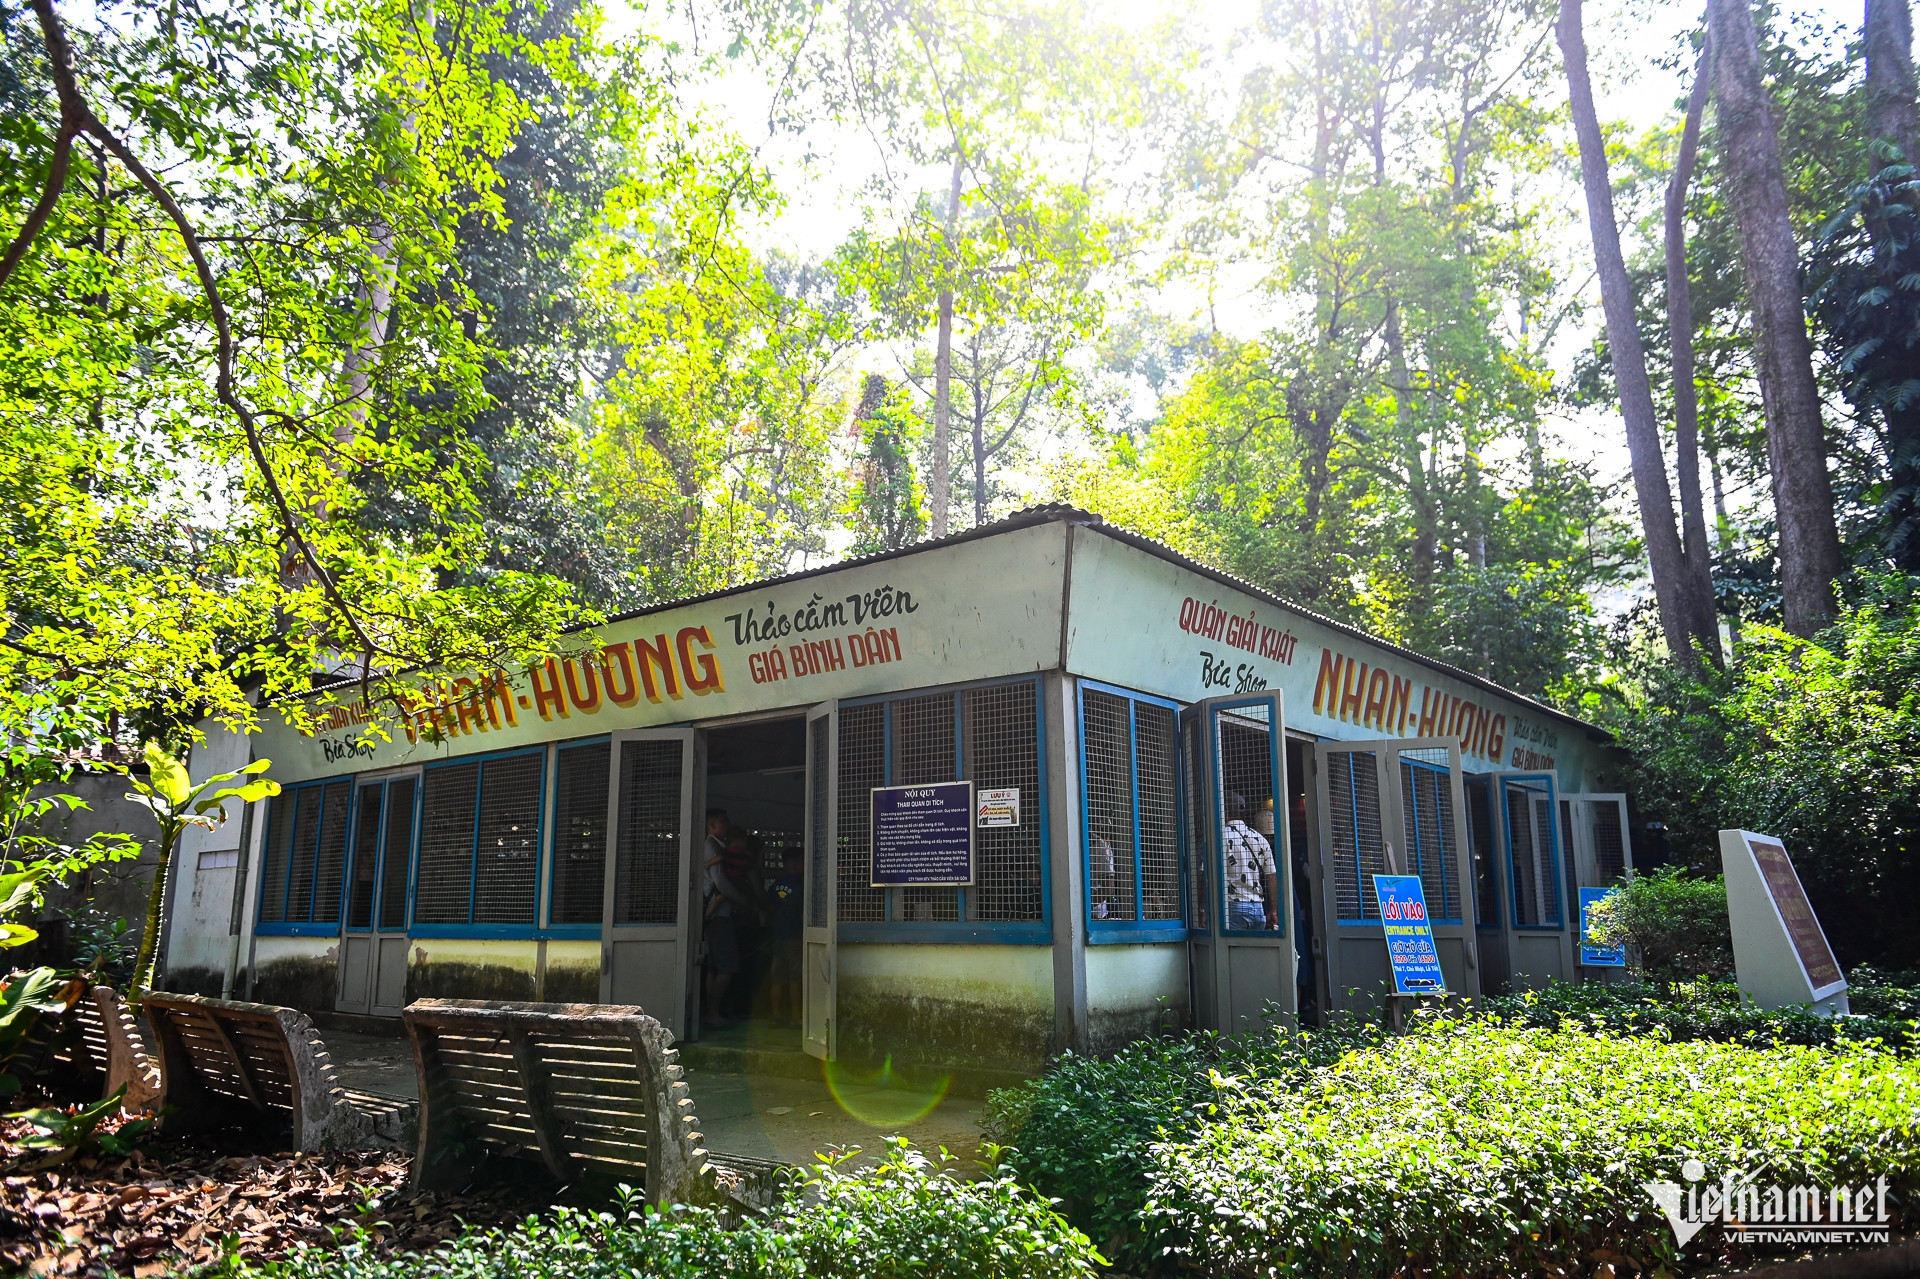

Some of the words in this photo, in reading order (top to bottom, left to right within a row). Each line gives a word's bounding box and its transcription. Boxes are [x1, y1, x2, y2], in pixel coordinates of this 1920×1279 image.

[724, 600, 792, 646] Thảo
[846, 584, 919, 625] Viên
[1179, 597, 1228, 643] QUÁN
[1225, 610, 1259, 654] GIẢI
[1258, 629, 1298, 666] KHÁT
[749, 643, 788, 684] GIÁ
[789, 638, 846, 678] BÌNH
[847, 626, 902, 669] DÂN
[1200, 650, 1231, 689] Bia
[1312, 648, 1507, 764] NHAN-HƯƠNG
[319, 739, 346, 764] Bia
[904, 789, 918, 799] NỘI
[919, 789, 936, 798] QUY
[932, 798, 944, 806] TÍCH
[1382, 895, 1401, 919] LỐI
[1400, 897, 1424, 919] VÀO
[1386, 926, 1414, 936] ENTRANCE
[1414, 926, 1429, 936] ONLY
